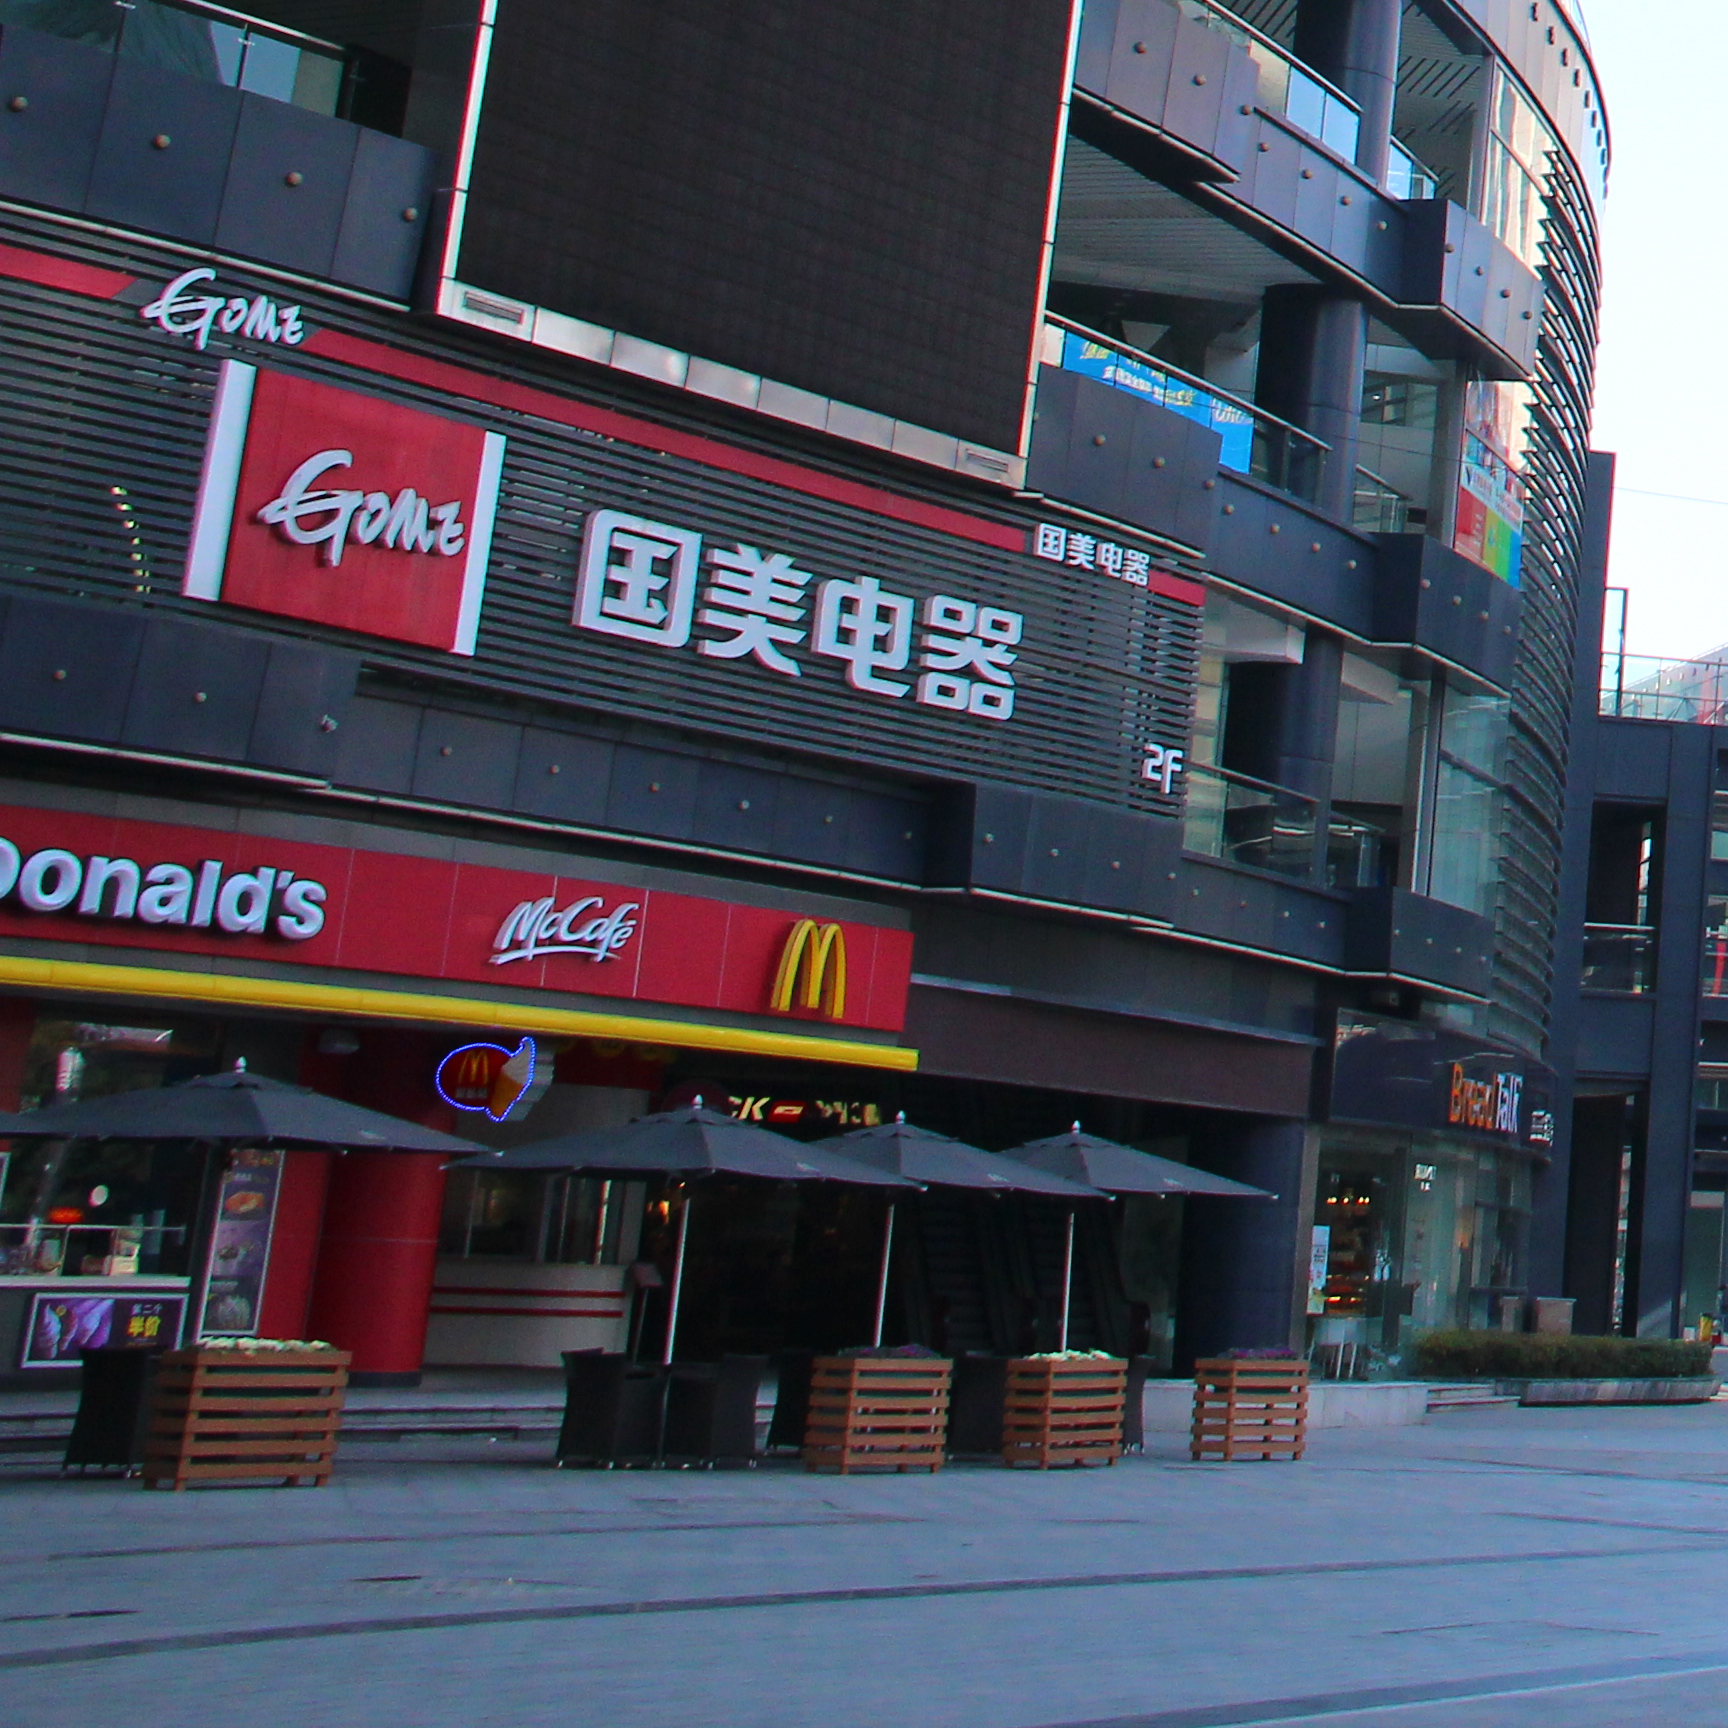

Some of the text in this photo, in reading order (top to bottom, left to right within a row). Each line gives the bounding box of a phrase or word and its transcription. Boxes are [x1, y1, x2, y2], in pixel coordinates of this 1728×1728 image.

[1035, 522, 1151, 587] 国美电器
[572, 508, 1023, 721] 国美电器
[1142, 743, 1183, 794] 2F
